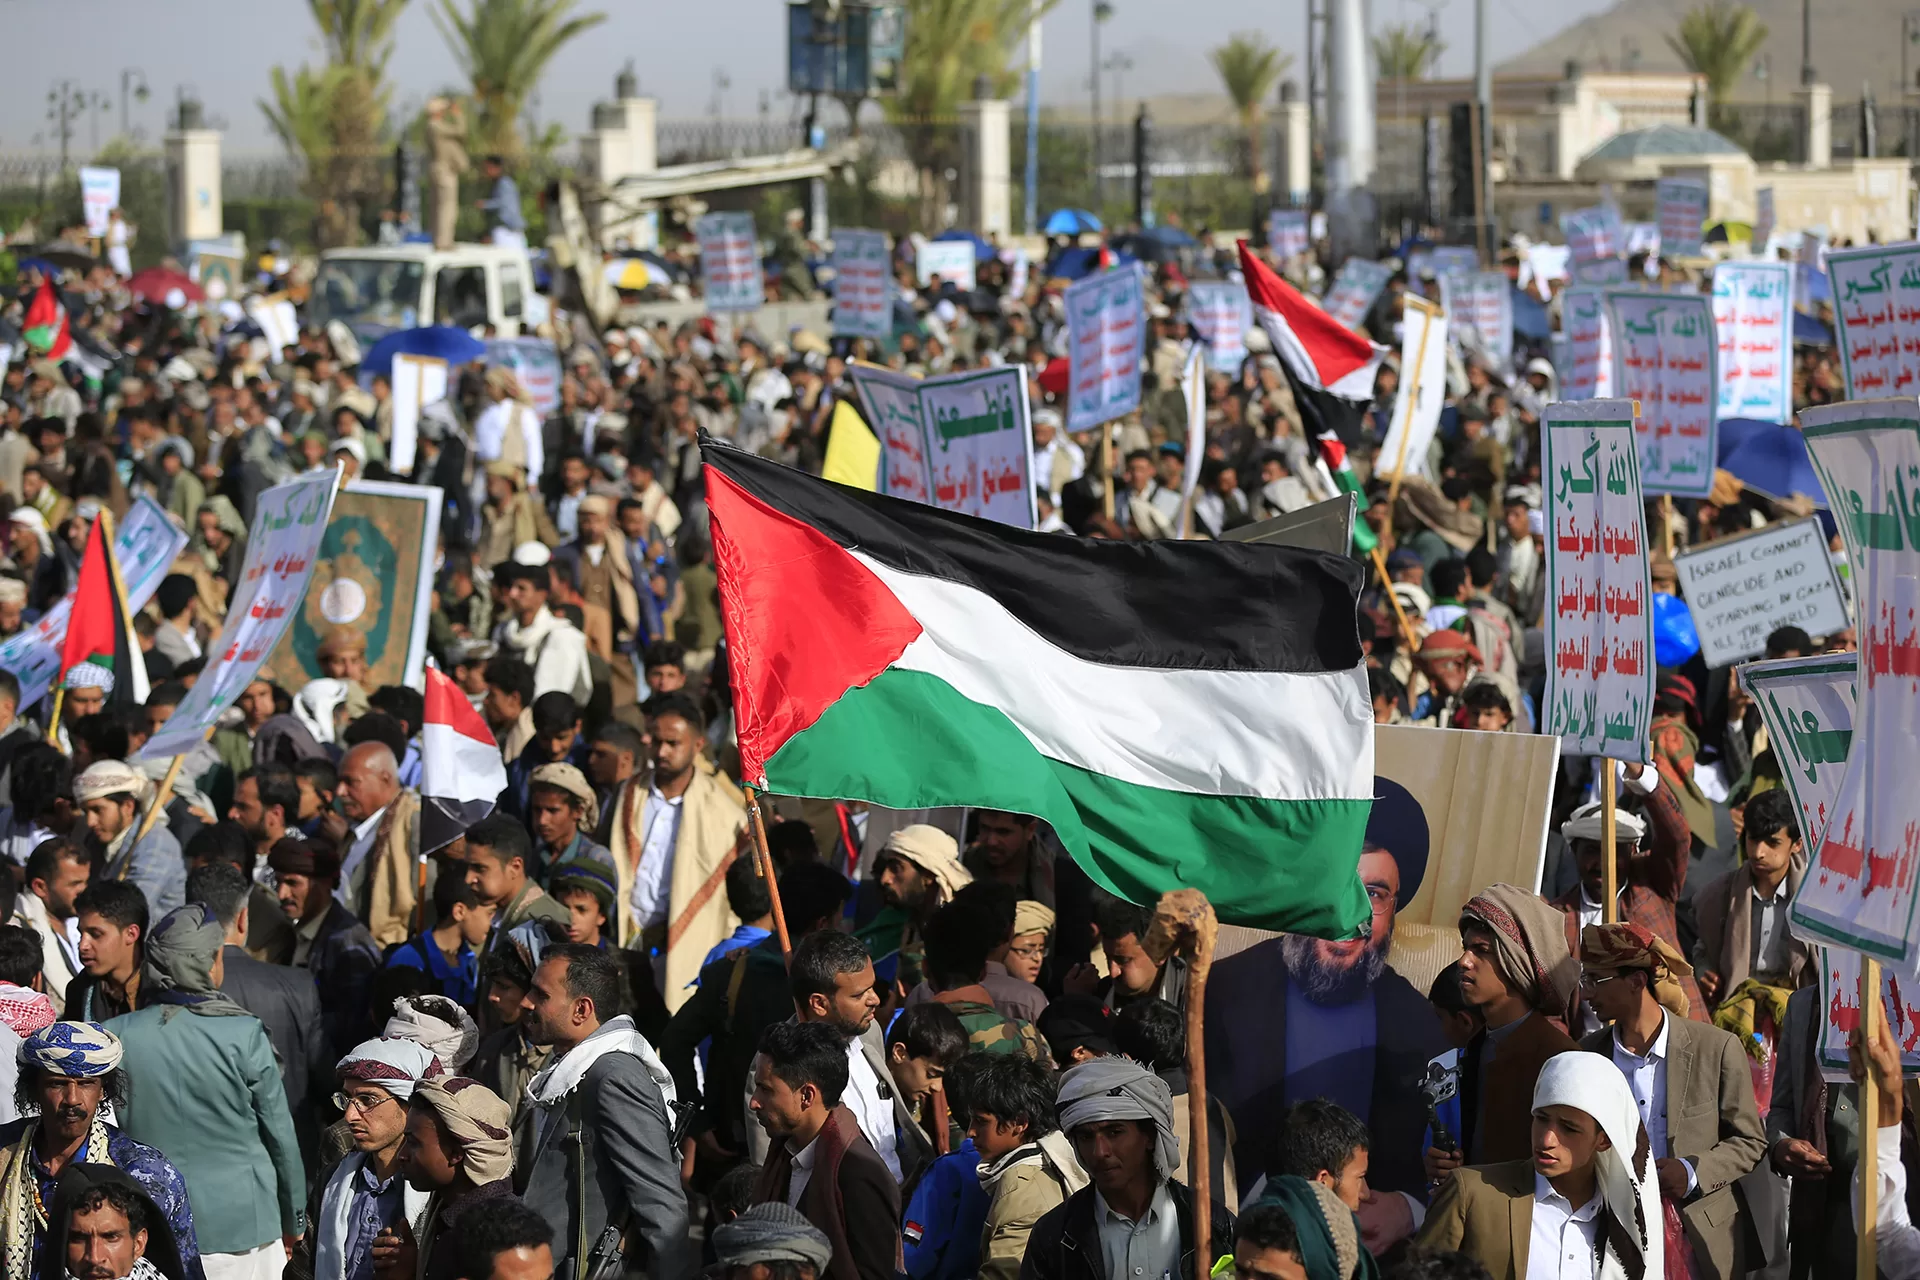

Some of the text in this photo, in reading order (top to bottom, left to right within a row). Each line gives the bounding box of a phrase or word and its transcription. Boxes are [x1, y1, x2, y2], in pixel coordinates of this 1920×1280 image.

[1844, 259, 1893, 305] أكبر
[1556, 432, 1600, 511] أكبر
[1606, 440, 1635, 495] الله
[1603, 519, 1641, 563] الموت
[1688, 549, 1747, 582] ISRAEL
[1697, 560, 1806, 610] GENOCIDE AND
[1605, 579, 1643, 624] الموت
[1706, 579, 1832, 630] STARVING IN GAZA
[1737, 622, 1763, 642] THE
[1768, 604, 1818, 629] WORLD
[1557, 633, 1644, 681] اللعنة على اليهود
[1599, 689, 1643, 752] النصر
